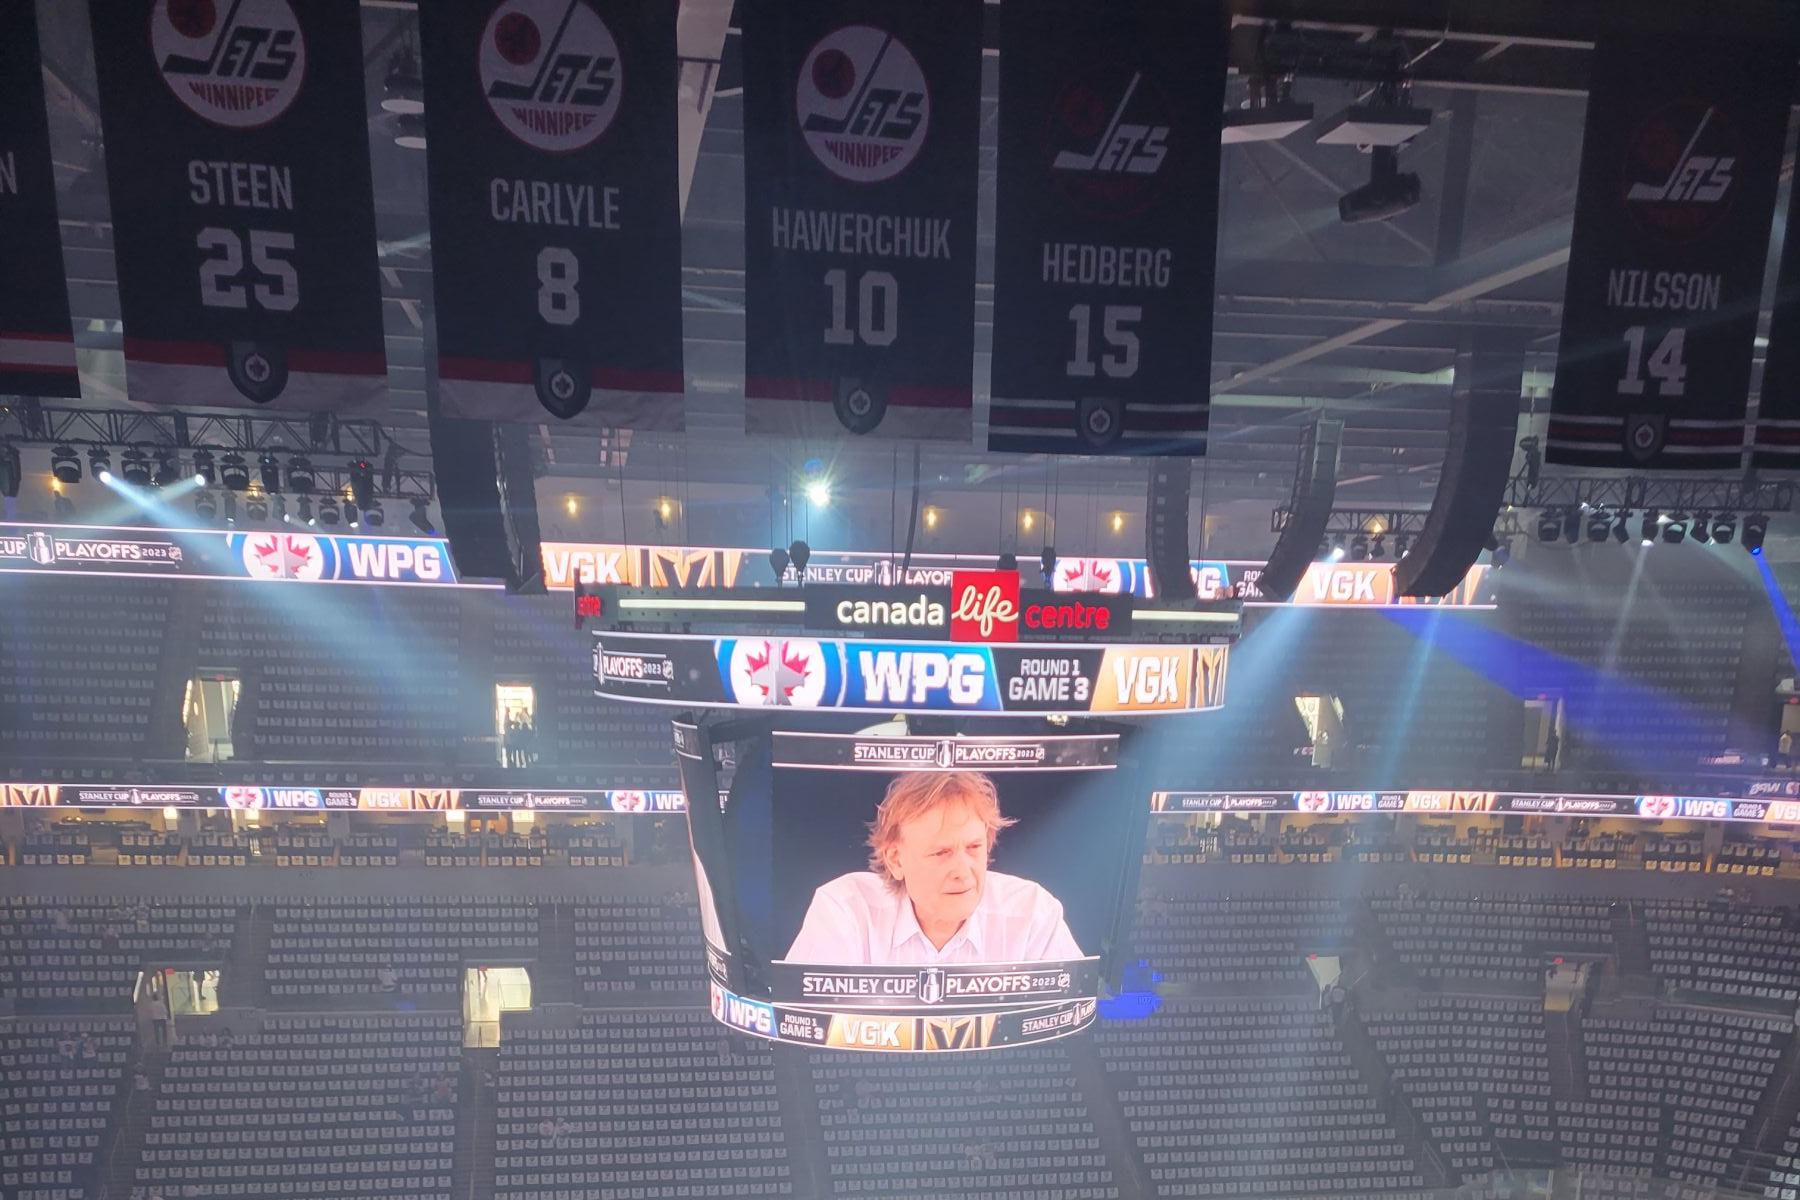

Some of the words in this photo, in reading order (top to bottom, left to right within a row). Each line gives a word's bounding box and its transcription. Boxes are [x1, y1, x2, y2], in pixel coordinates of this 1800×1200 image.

[802, 31, 925, 141] JETS
[1052, 70, 1171, 174] JETS
[1627, 106, 1736, 202] JETS
[187, 159, 294, 211] STEEN
[489, 177, 622, 231] CARLYLE
[771, 205, 952, 260] HAWERCHUK
[196, 226, 300, 313] 25
[1042, 242, 1173, 289] HEDBERG
[536, 245, 581, 327] 8
[1606, 267, 1722, 311] NILSSON
[822, 268, 899, 347] 10
[1066, 303, 1143, 378] 15
[1617, 325, 1688, 396] 14
[55, 541, 140, 560] PLAYOFFS
[142, 547, 167, 558] 2023
[346, 542, 442, 580] WPG
[545, 550, 622, 584] VGK
[845, 568, 873, 583] CUP
[1312, 568, 1377, 601] VGK
[837, 594, 945, 626] canada
[951, 584, 1019, 638] life
[1024, 601, 1112, 631] centre
[602, 655, 643, 679] PLAYOFFS
[643, 662, 661, 675] 2023
[857, 649, 986, 706] WPG
[1020, 659, 1070, 677] ROUND
[1072, 659, 1080, 677] 1
[1112, 655, 1181, 704] VGK
[1008, 677, 1070, 702] GAME
[1073, 677, 1090, 702] 3
[854, 747, 909, 760] STANLEY
[911, 747, 935, 760] CUP
[955, 747, 1017, 761] PLAYOFFS
[273, 790, 319, 808] WPG
[1337, 794, 1373, 810] WPG
[1684, 799, 1728, 817] WPG
[802, 975, 879, 995] STANLEY
[881, 976, 917, 995] CUP
[946, 974, 1030, 994] PLAYOFFS
[1032, 975, 1056, 987] 2023
[728, 997, 771, 1033] WPG
[779, 1022, 811, 1039] GAME
[784, 1014, 811, 1027] ROUND
[811, 1017, 818, 1027] 1
[841, 1019, 902, 1047] VGK
[1021, 1016, 1058, 1033] STANLEY
[1059, 1012, 1074, 1026] CUP
